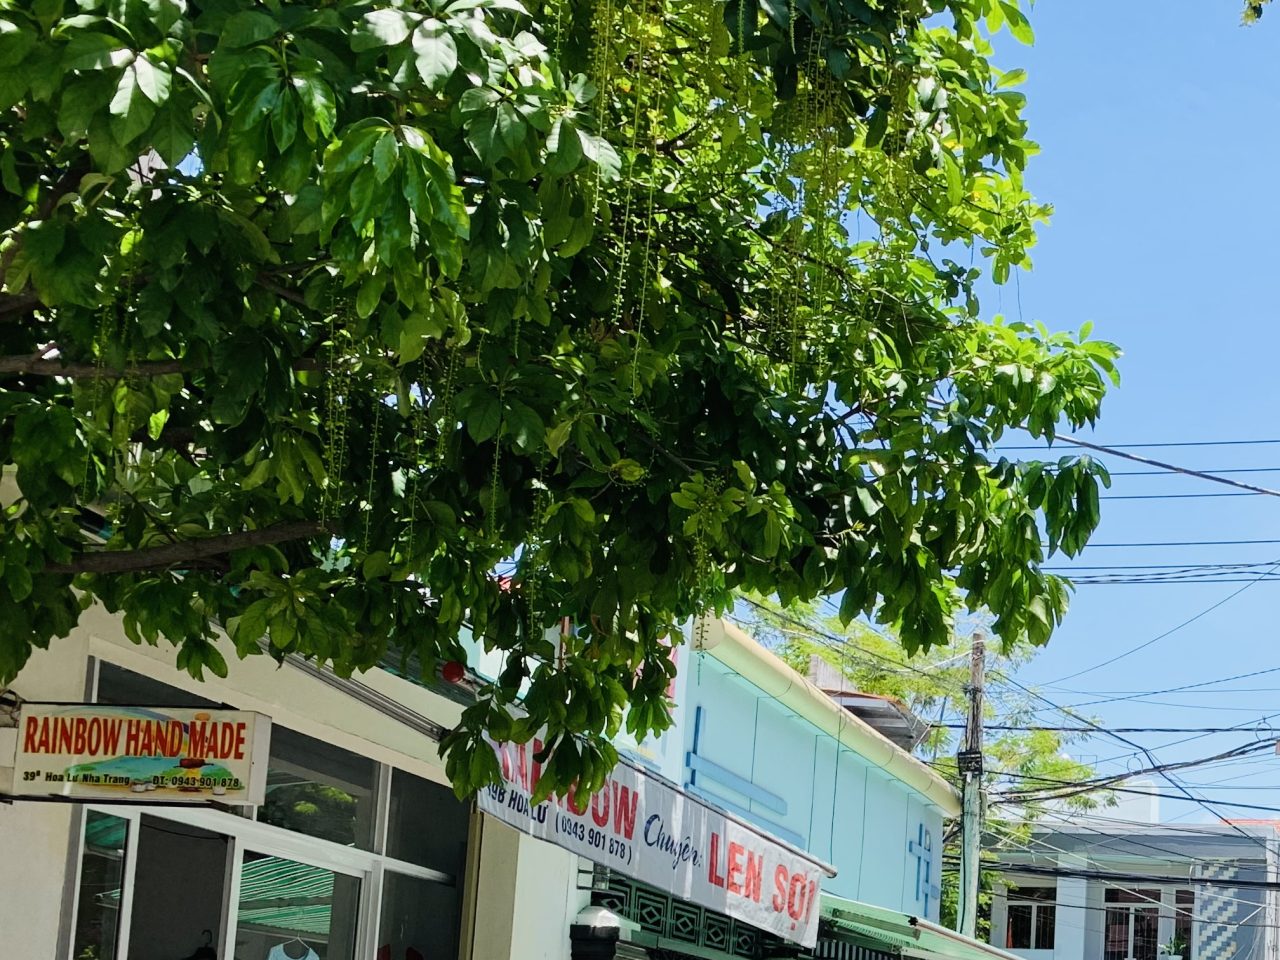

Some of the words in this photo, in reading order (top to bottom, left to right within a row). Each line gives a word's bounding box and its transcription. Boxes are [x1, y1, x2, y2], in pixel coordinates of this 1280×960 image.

[23, 716, 123, 757] RAINBOW
[125, 719, 183, 758] HAND
[188, 720, 246, 759] MADE
[45, 772, 64, 782] Hoa
[81, 773, 100, 783] Nha
[103, 774, 131, 786] Trang
[171, 776, 196, 786] 0943
[199, 777, 217, 787] 901
[220, 778, 240, 788] 878
[508, 789, 529, 817] HOA
[588, 828, 606, 851] 901
[708, 831, 763, 904] LEN
[772, 863, 816, 931] SỢI
